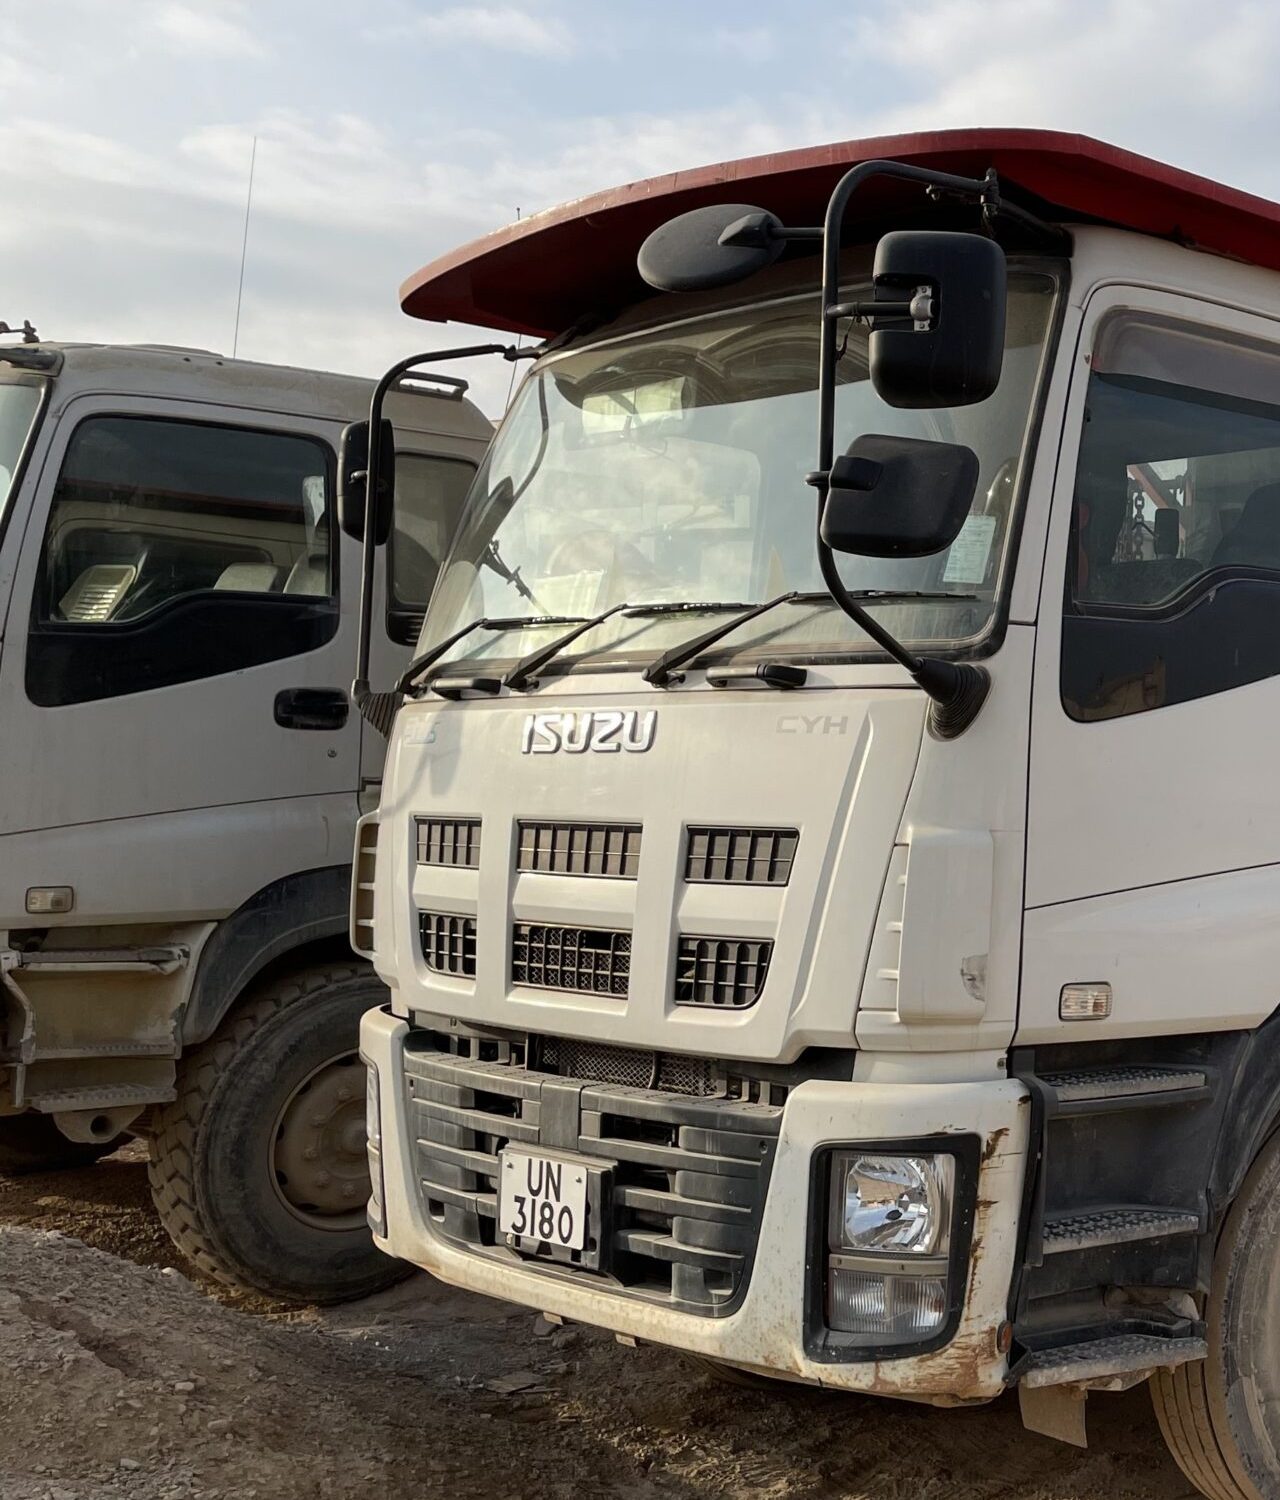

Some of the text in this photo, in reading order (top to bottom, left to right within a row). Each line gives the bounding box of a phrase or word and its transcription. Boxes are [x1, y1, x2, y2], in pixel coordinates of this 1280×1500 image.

[521, 710, 658, 754] ISUZU
[776, 715, 848, 735] CYH
[527, 1158, 562, 1202] UN
[511, 1195, 573, 1244] 3180
